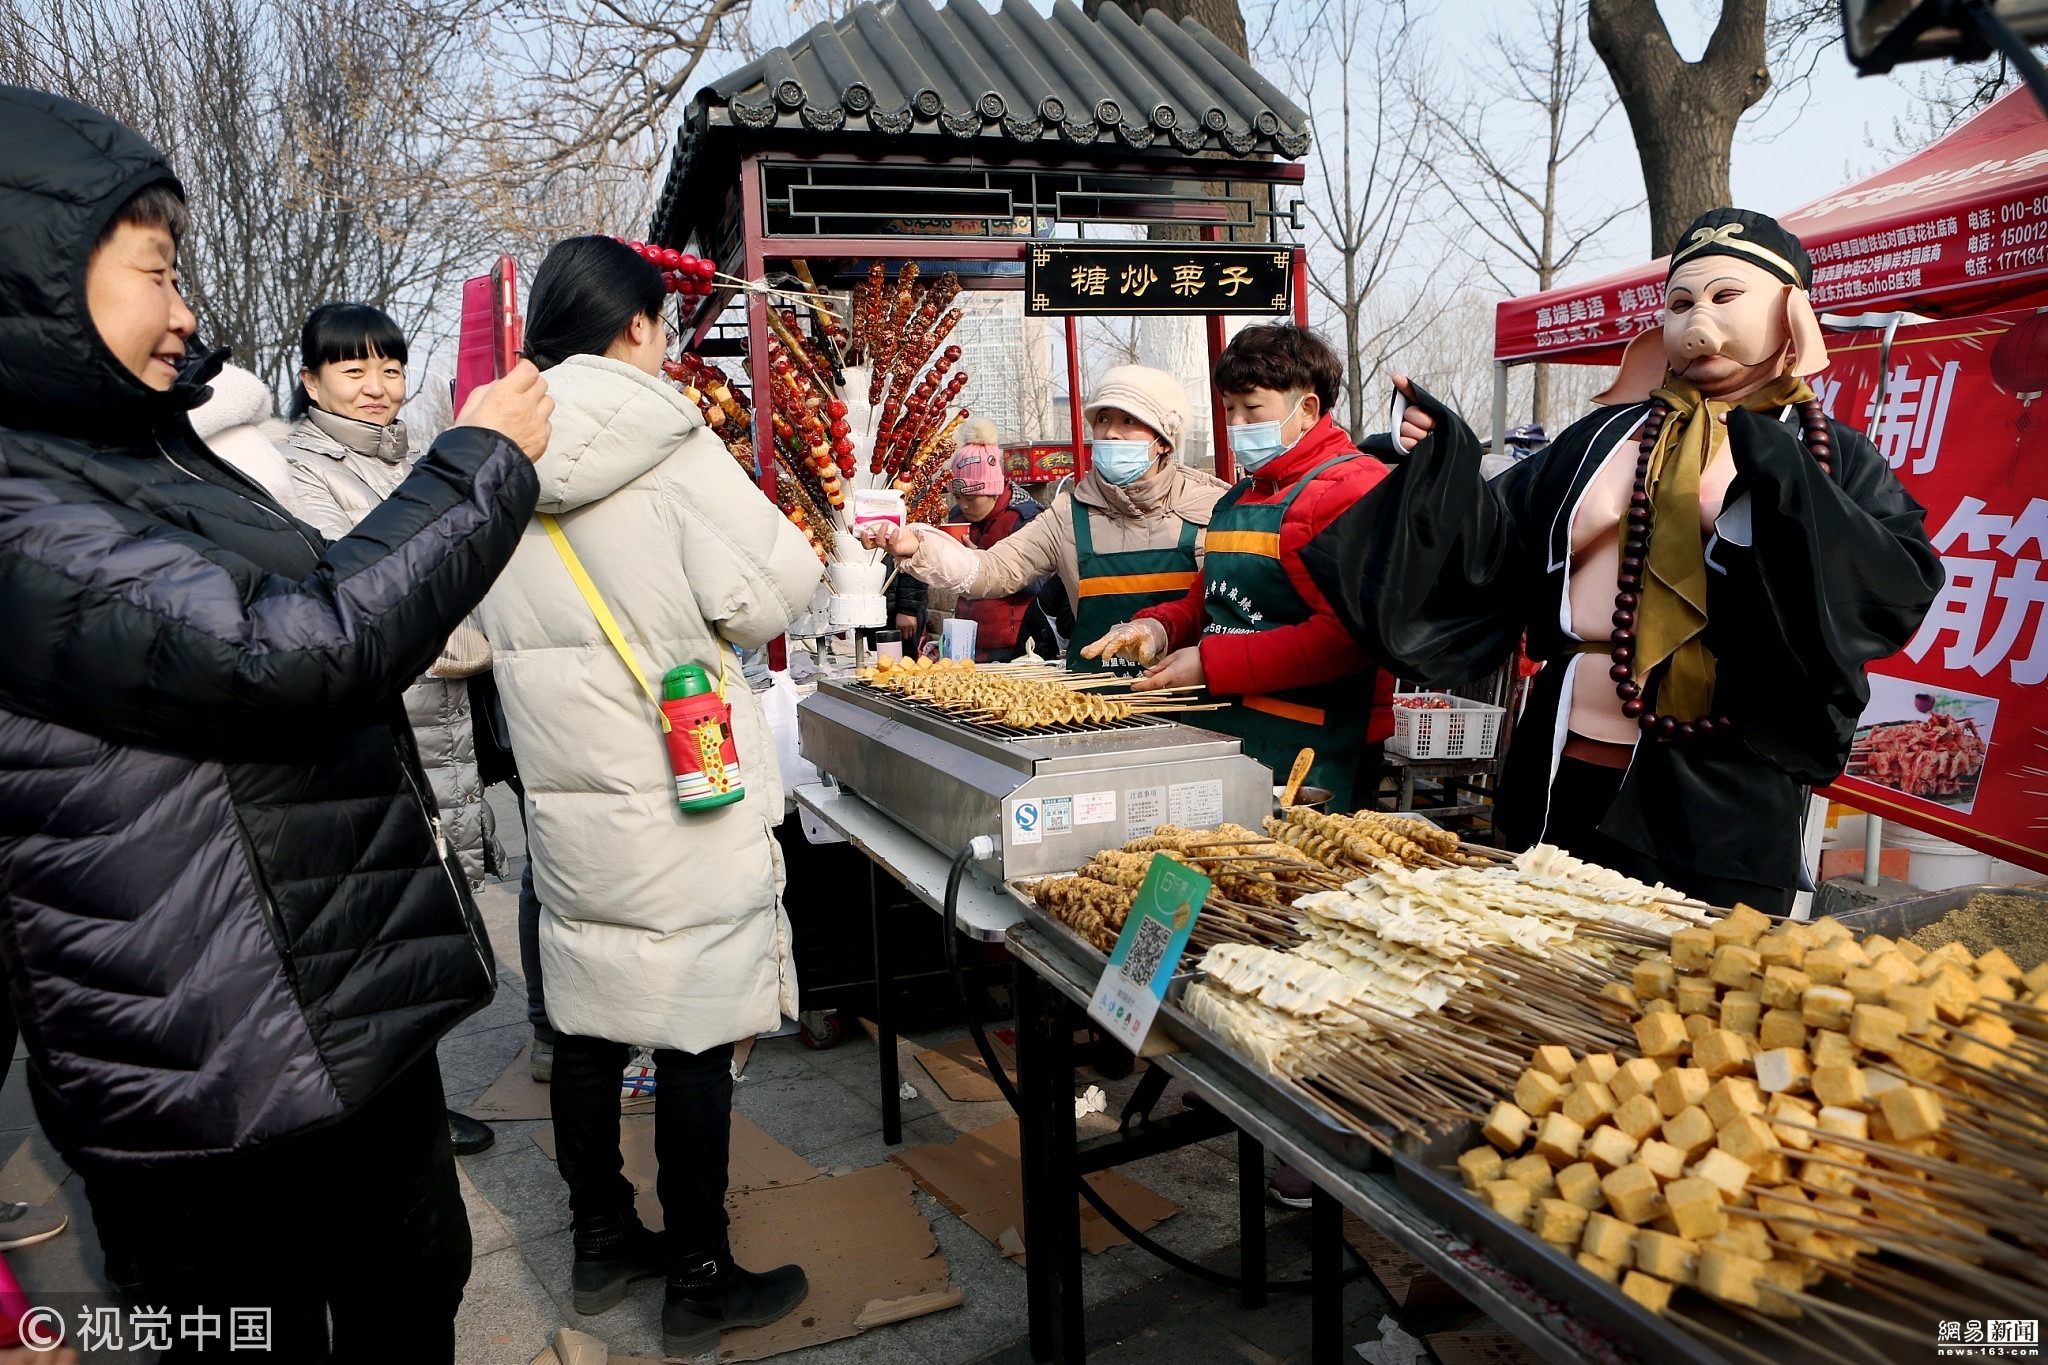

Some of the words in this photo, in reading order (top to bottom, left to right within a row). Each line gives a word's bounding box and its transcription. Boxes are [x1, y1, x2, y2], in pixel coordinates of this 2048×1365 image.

[1070, 263, 1254, 297] 糖炒栗子
[1536, 295, 1606, 330] 高端美语
[1903, 496, 2048, 685] 筋
